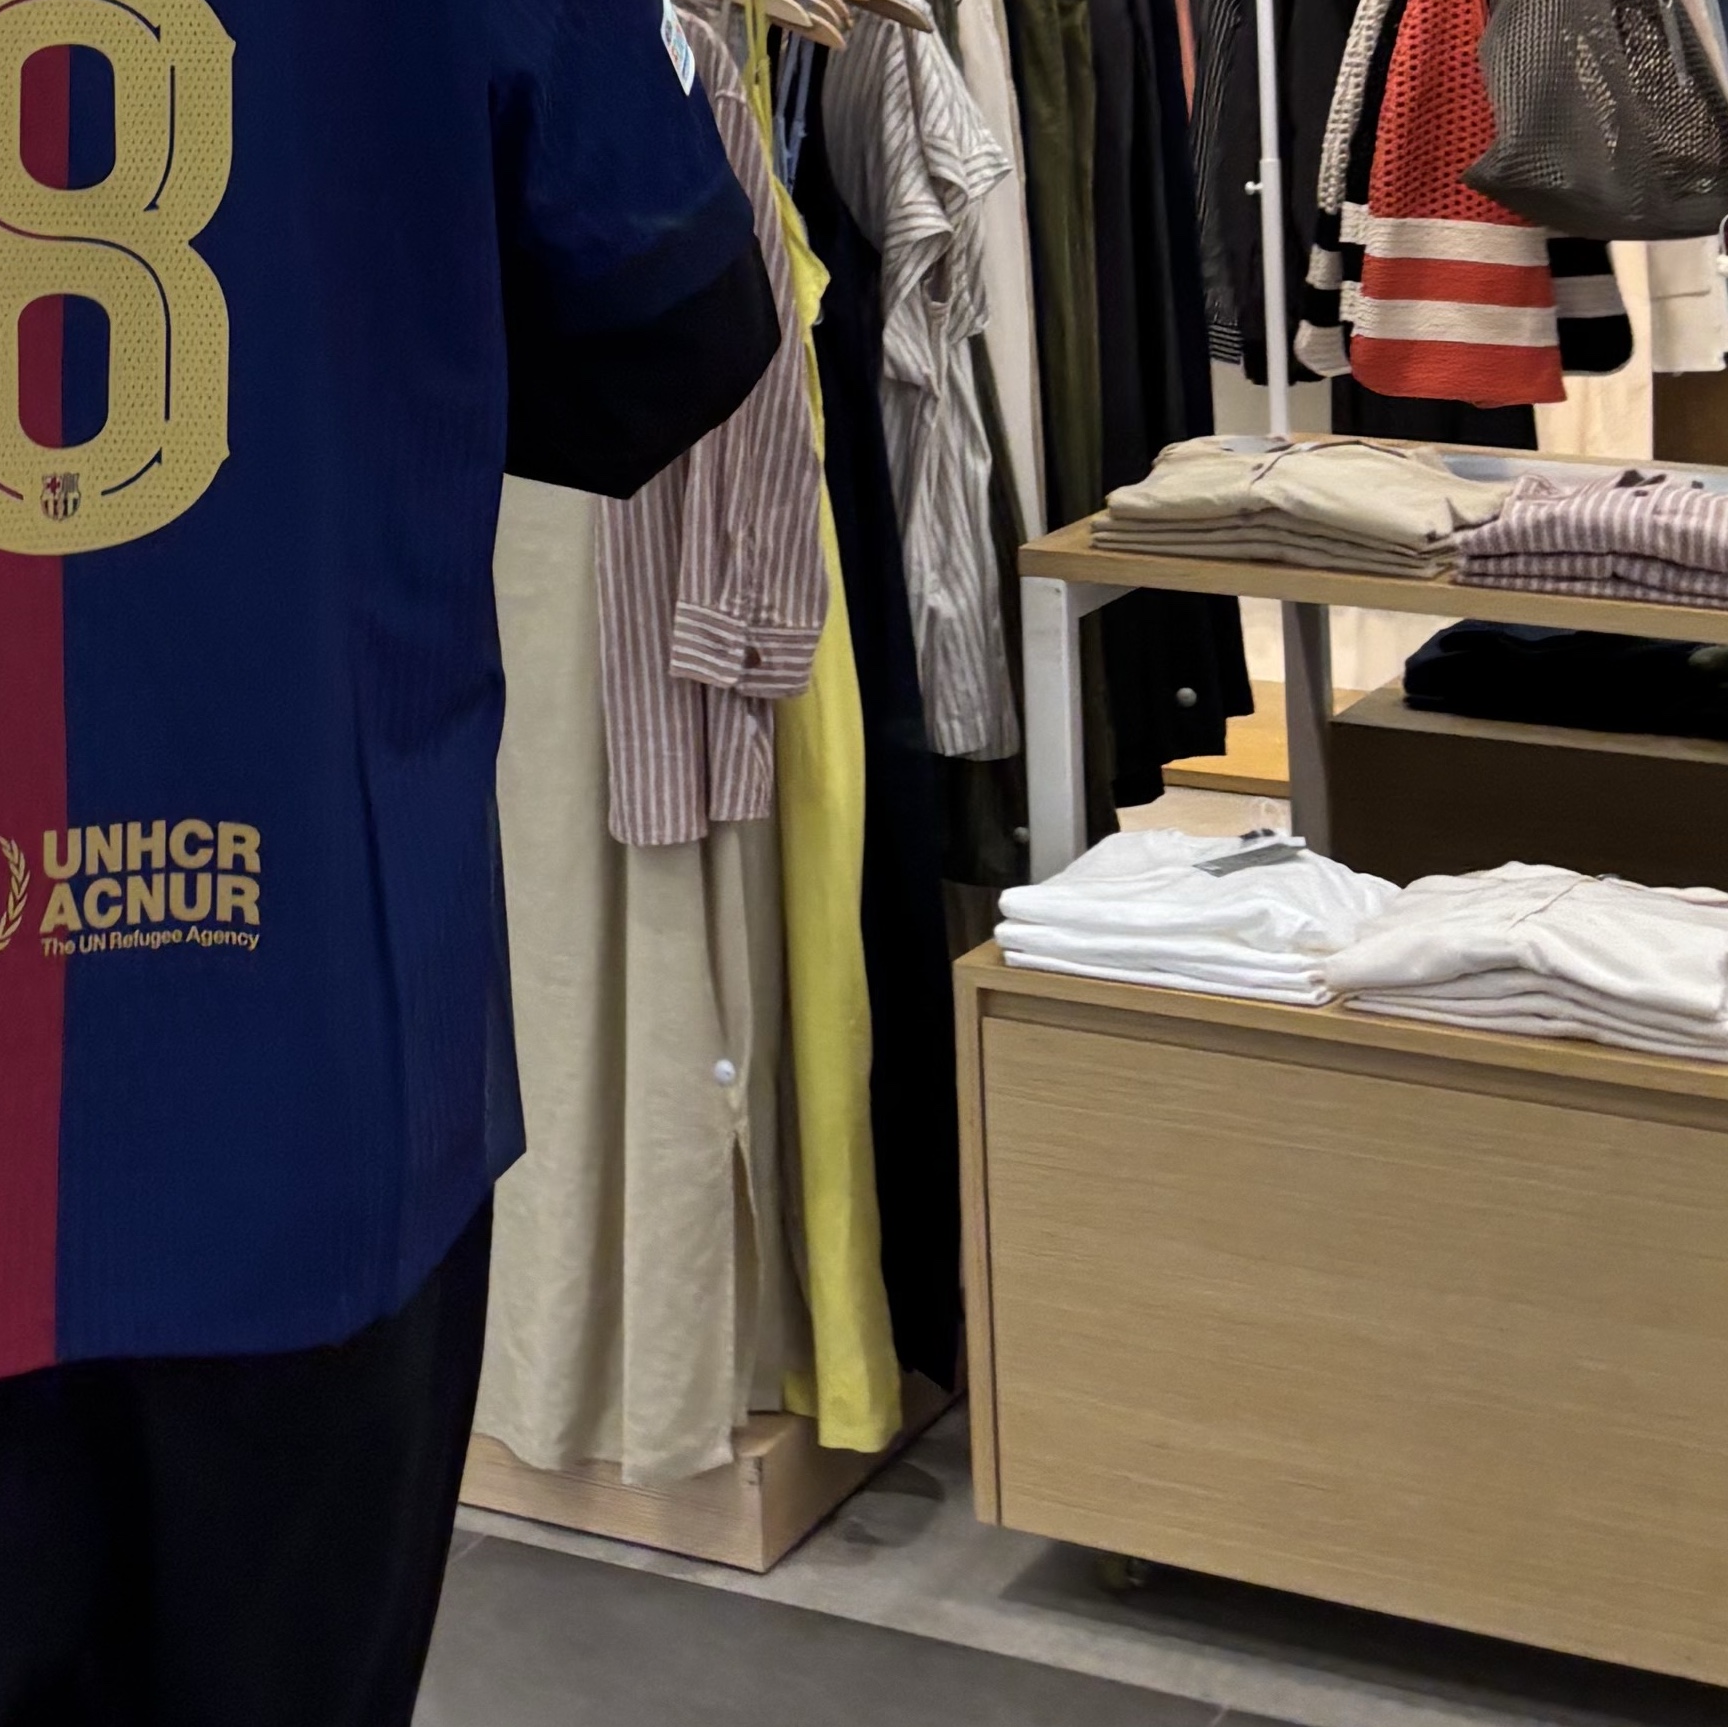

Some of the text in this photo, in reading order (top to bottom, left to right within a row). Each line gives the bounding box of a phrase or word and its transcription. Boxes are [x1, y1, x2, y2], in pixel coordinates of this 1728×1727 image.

[42, 818, 262, 880] UNHCR
[38, 873, 261, 934] ACNUR
[41, 925, 261, 957] The UN Refugee Agency
